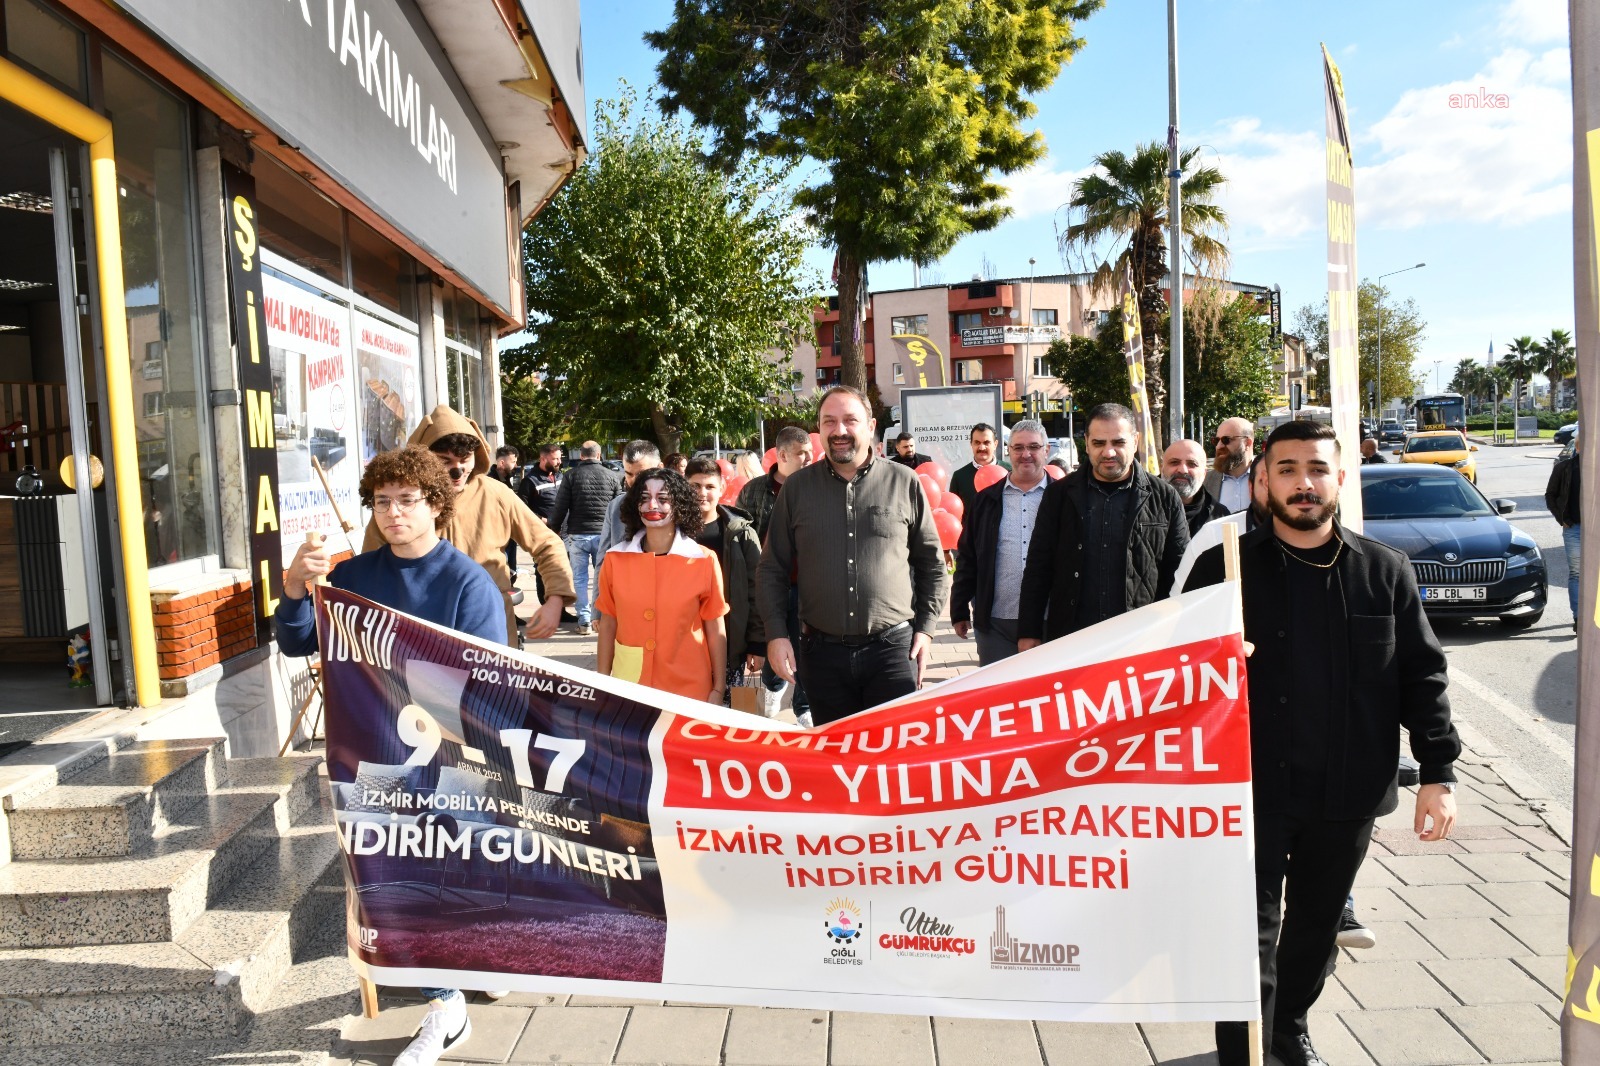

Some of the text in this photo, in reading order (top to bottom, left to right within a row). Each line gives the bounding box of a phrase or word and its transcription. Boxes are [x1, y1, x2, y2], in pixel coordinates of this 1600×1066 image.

[307, 353, 345, 392] KAMPANYA
[232, 196, 280, 618] ŞİMAL
[918, 435, 940, 443] (0232)
[941, 434, 953, 442] 502
[1427, 589, 1438, 598] 35
[1445, 589, 1462, 599] CBL
[1473, 589, 1484, 598] 15
[471, 667, 596, 701] 100. YILINA ÖZEL
[680, 654, 1240, 754] CUMHURİYETİMİZİN
[397, 704, 442, 766] 9
[500, 728, 586, 793] 17
[693, 726, 1219, 804] 100. YILINA ÖZEL
[483, 769, 502, 782] 2023
[361, 788, 591, 835] İZMİR MOBİLYA PERAKENDE
[675, 804, 1243, 856] İZMİR MOBİLYA PERAKENDE
[481, 821, 642, 880] GÜNLERİ
[785, 845, 1129, 889] İNDİRİM GÜNLERİ
[899, 906, 955, 936] Utku
[879, 934, 976, 956] GÜMRÜKÇÜ
[1013, 938, 1080, 963] İZMOP
